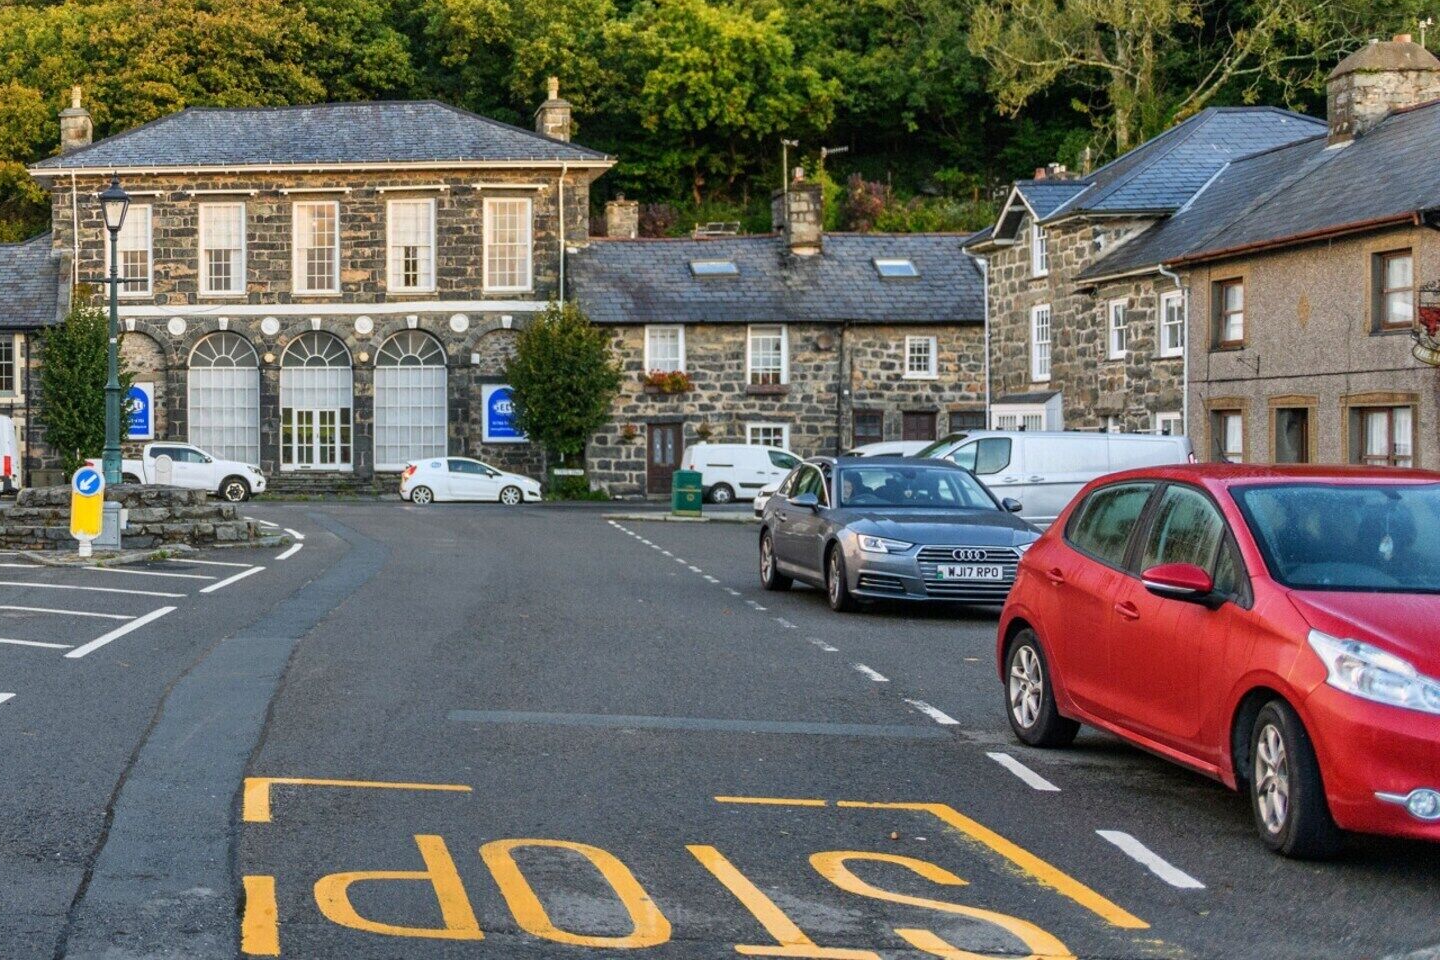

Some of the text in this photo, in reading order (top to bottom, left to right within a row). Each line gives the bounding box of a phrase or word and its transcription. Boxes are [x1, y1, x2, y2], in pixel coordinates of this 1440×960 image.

[948, 566, 999, 578] WJ17 RPO
[313, 834, 1078, 960] STOP
